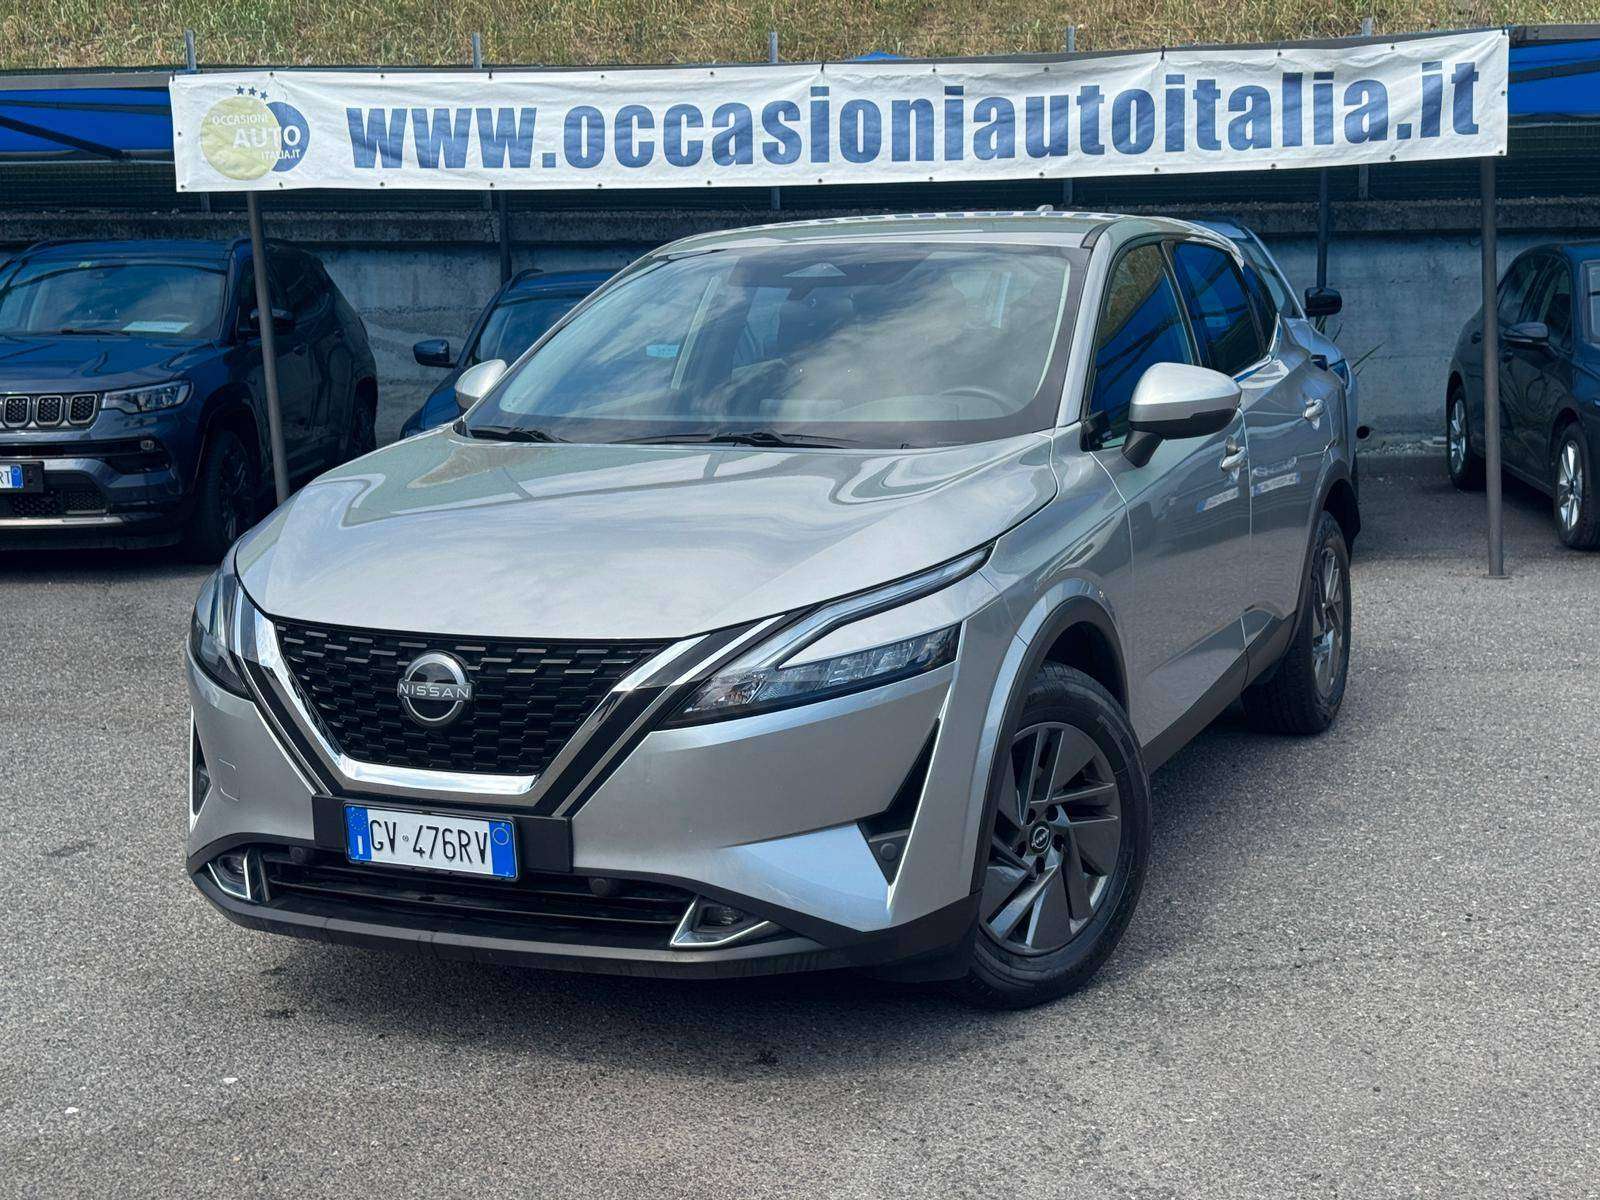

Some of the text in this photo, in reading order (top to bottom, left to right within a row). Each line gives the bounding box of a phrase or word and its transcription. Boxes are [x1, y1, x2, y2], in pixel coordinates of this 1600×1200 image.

[212, 113, 268, 126] OCCASIONI
[346, 61, 1479, 169] www.occasioniautoitalia.it
[232, 125, 302, 149] AUTO
[261, 149, 301, 160] ITALIA.IT
[399, 683, 470, 698] NISSAN
[369, 819, 397, 856] GV
[412, 824, 488, 865] 476RV
